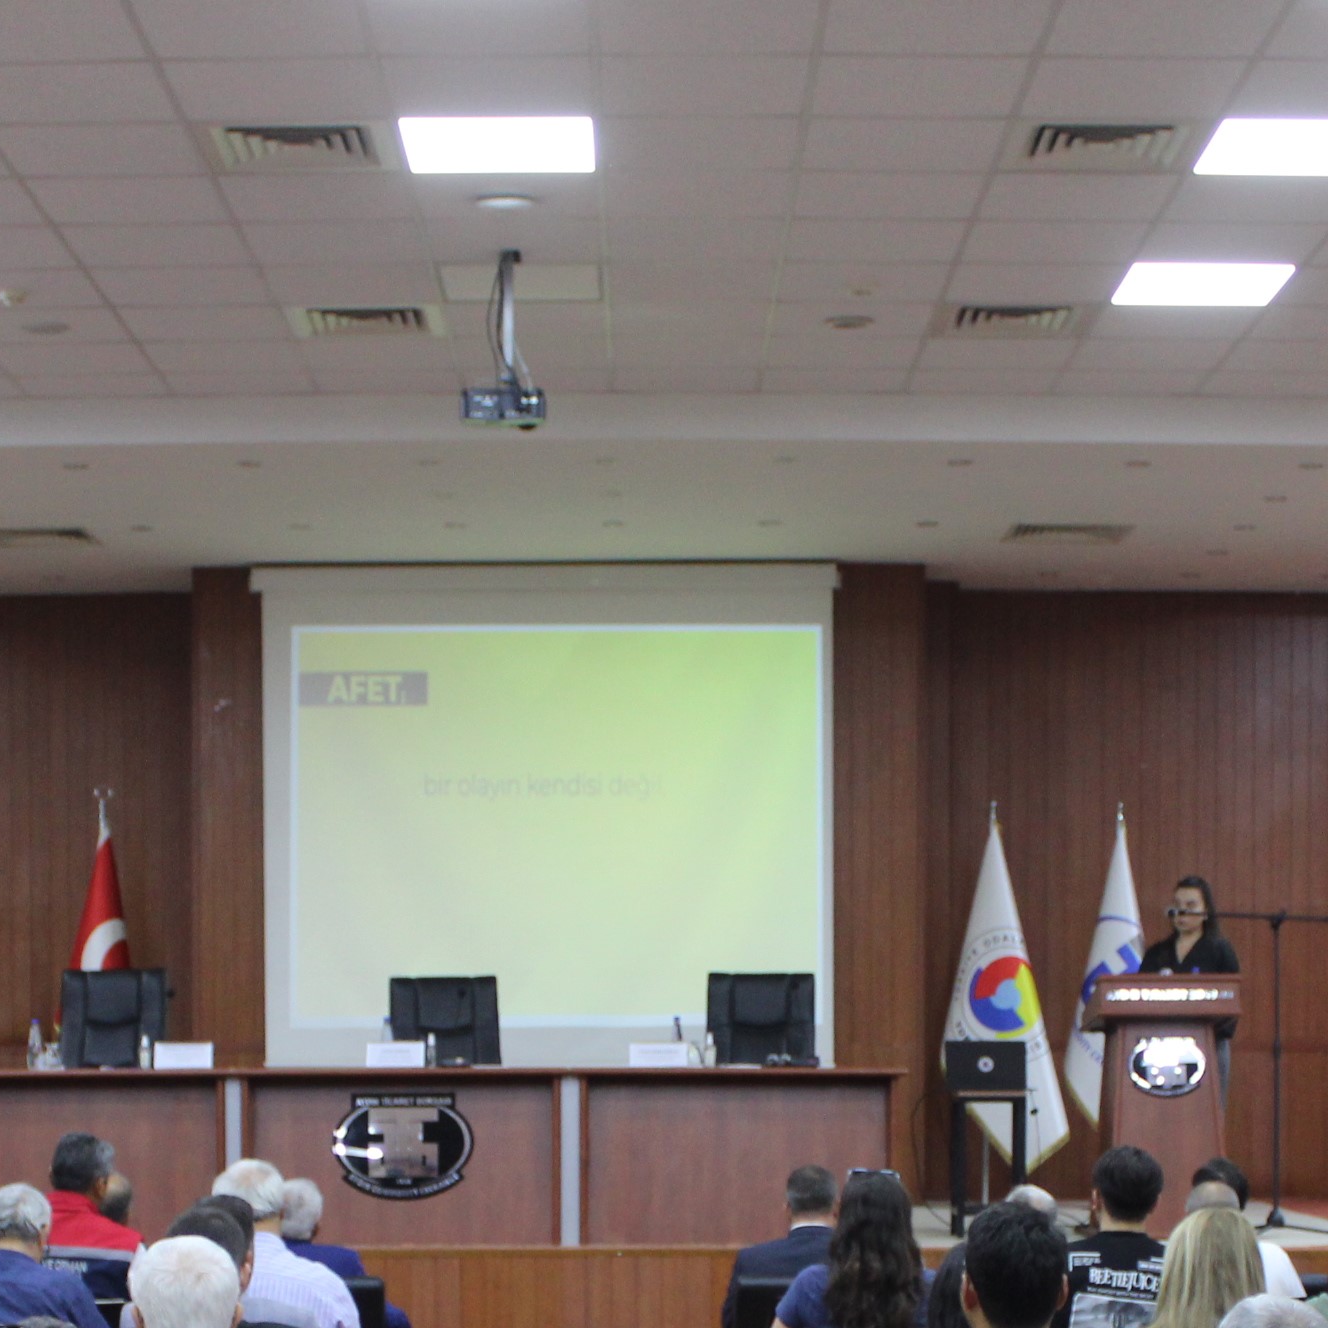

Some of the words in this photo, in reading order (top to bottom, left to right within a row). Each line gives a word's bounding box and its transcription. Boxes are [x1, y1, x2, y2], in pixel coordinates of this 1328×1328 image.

[326, 674, 402, 704] AFET
[423, 772, 452, 797] bir
[458, 773, 520, 802] olayın
[527, 771, 602, 797] kendisi
